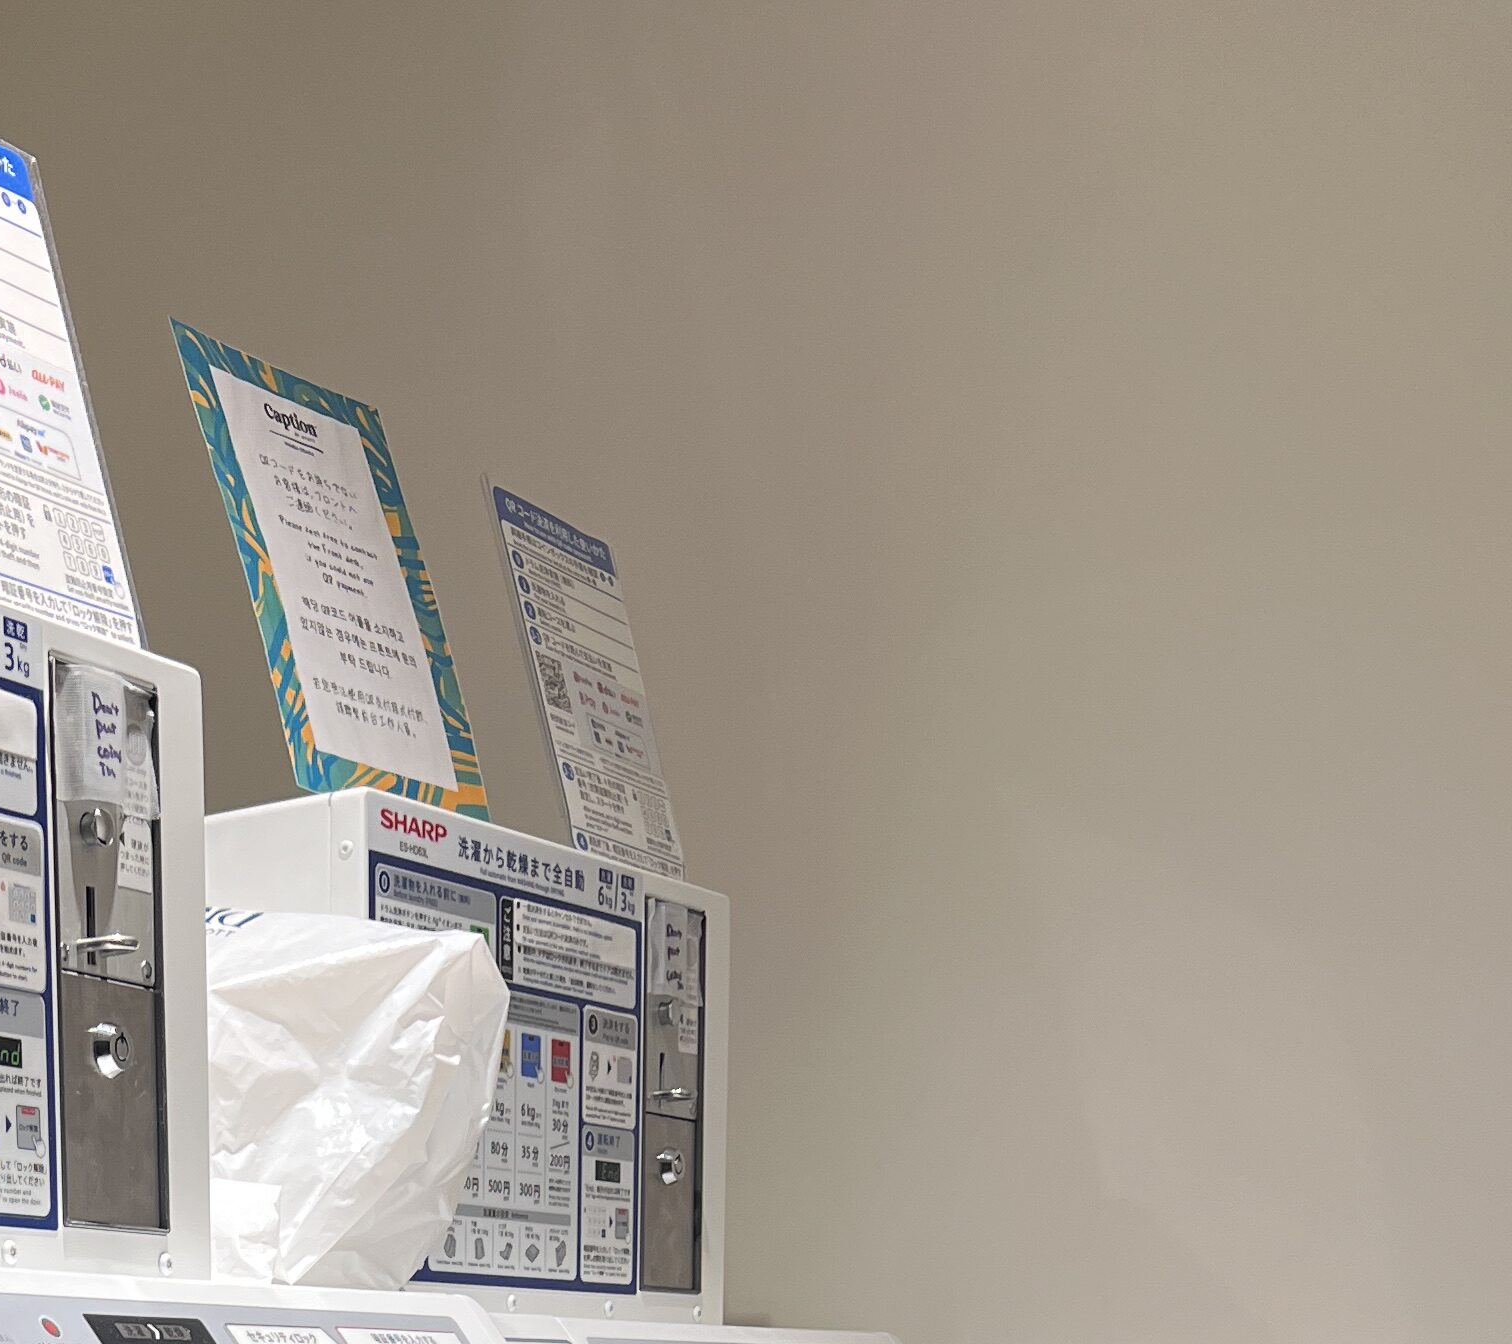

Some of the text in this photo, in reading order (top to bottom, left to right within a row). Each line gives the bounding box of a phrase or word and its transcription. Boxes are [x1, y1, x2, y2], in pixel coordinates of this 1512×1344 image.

[263, 402, 318, 438] Caption
[380, 807, 448, 843] SHARP
[457, 835, 586, 893] 洗濯から乾燥まで全自動
